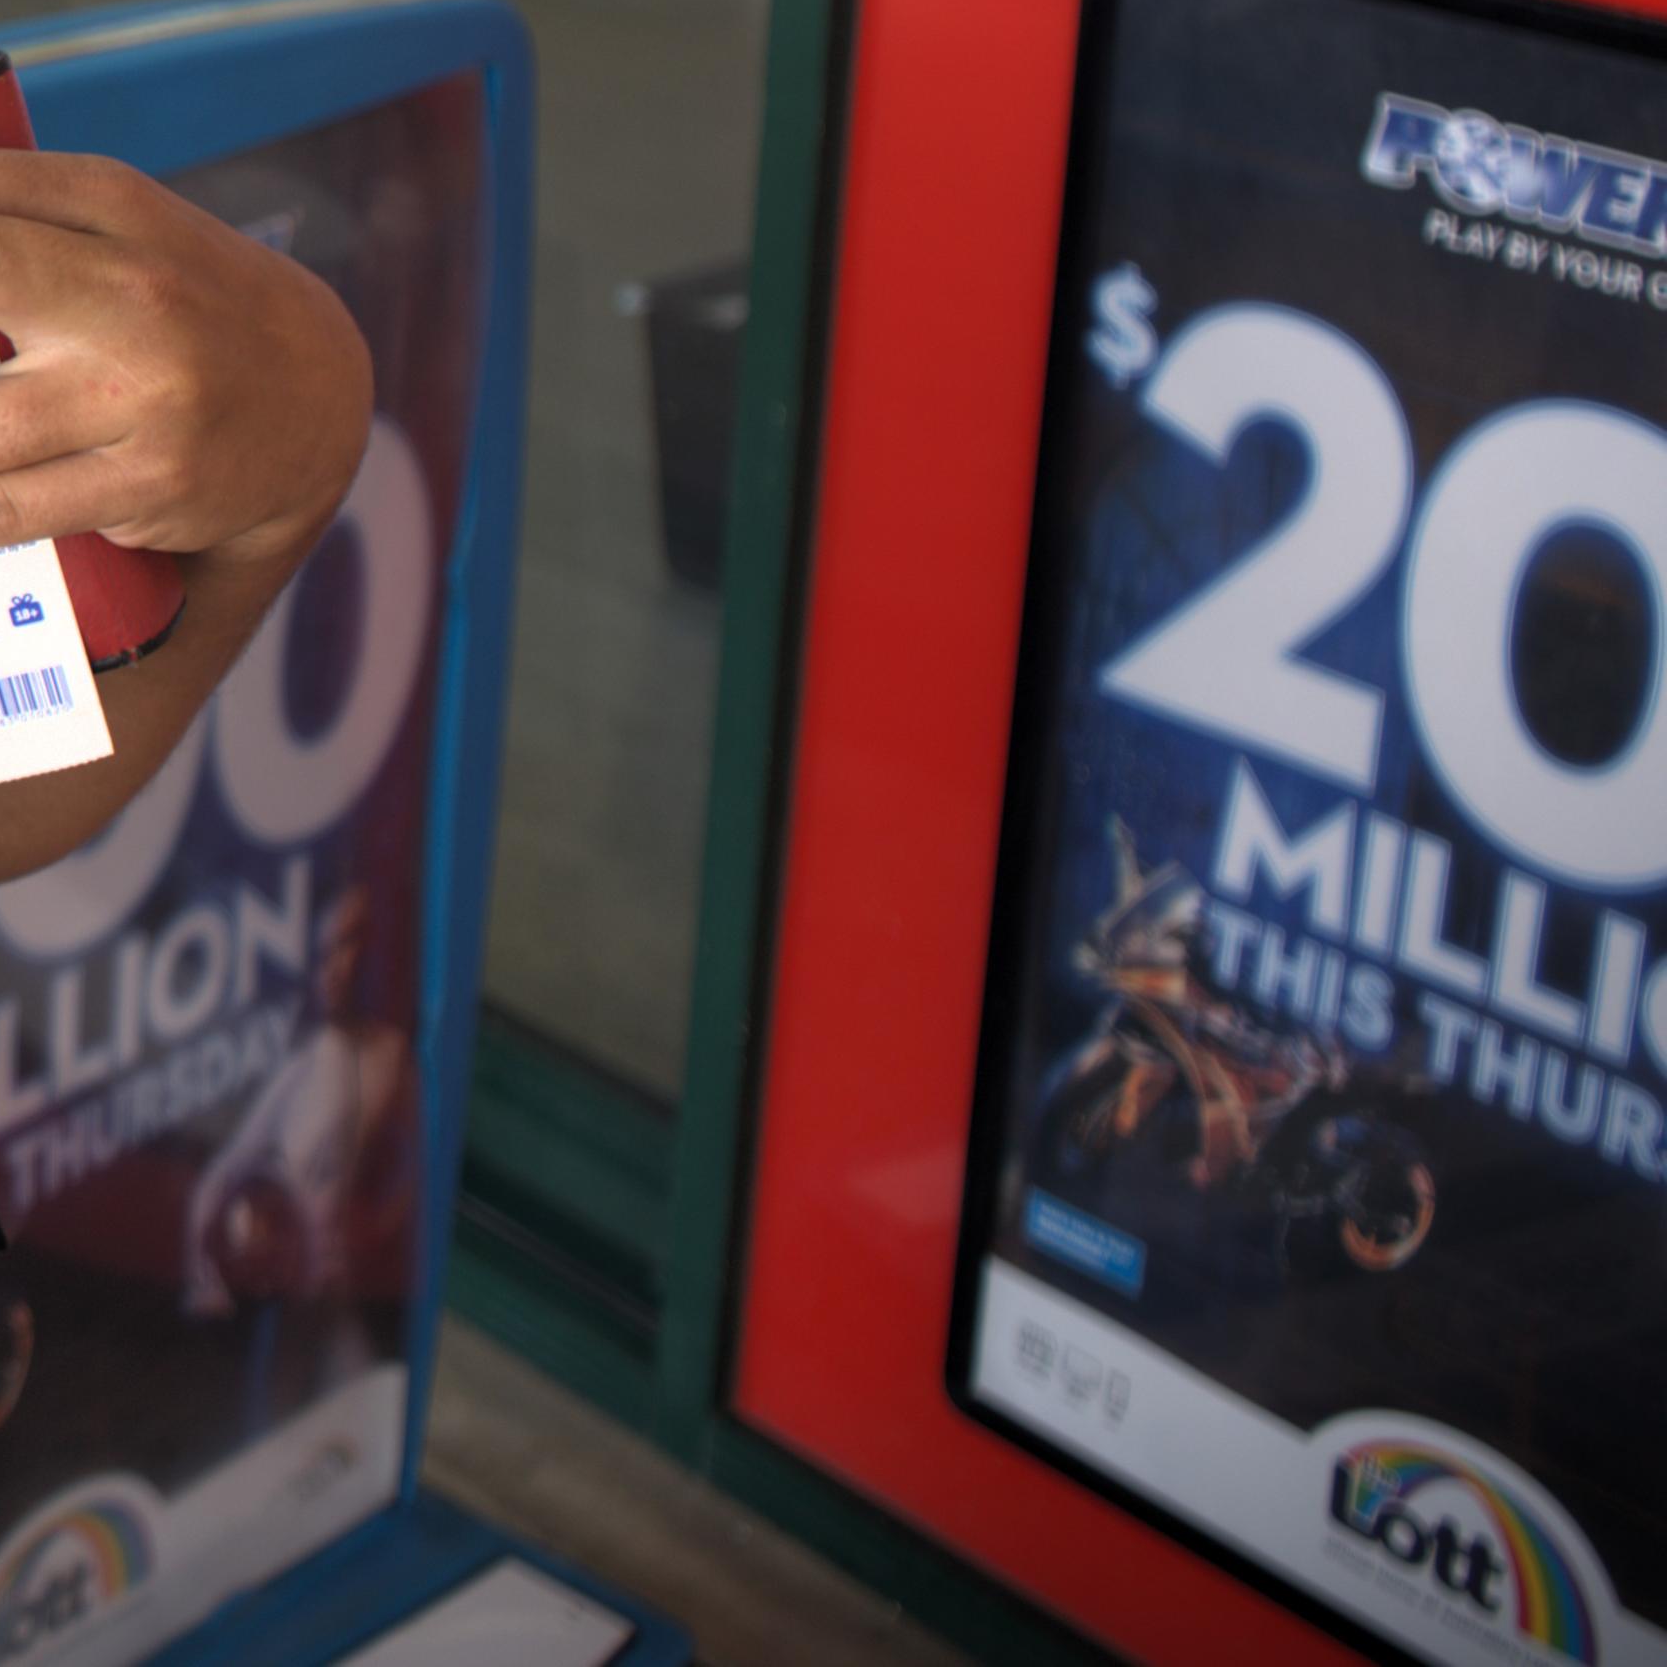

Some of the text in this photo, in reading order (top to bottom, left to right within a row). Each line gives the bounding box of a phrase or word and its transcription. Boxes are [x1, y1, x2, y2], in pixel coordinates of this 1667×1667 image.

[1423, 206, 1644, 303] PLAY BY YOUR
[14, 607, 41, 623] 18+
[7, 997, 301, 1218] THURSDAY
[1210, 898, 1667, 1188] THIS THUR
[1331, 1452, 1507, 1616] Lott
